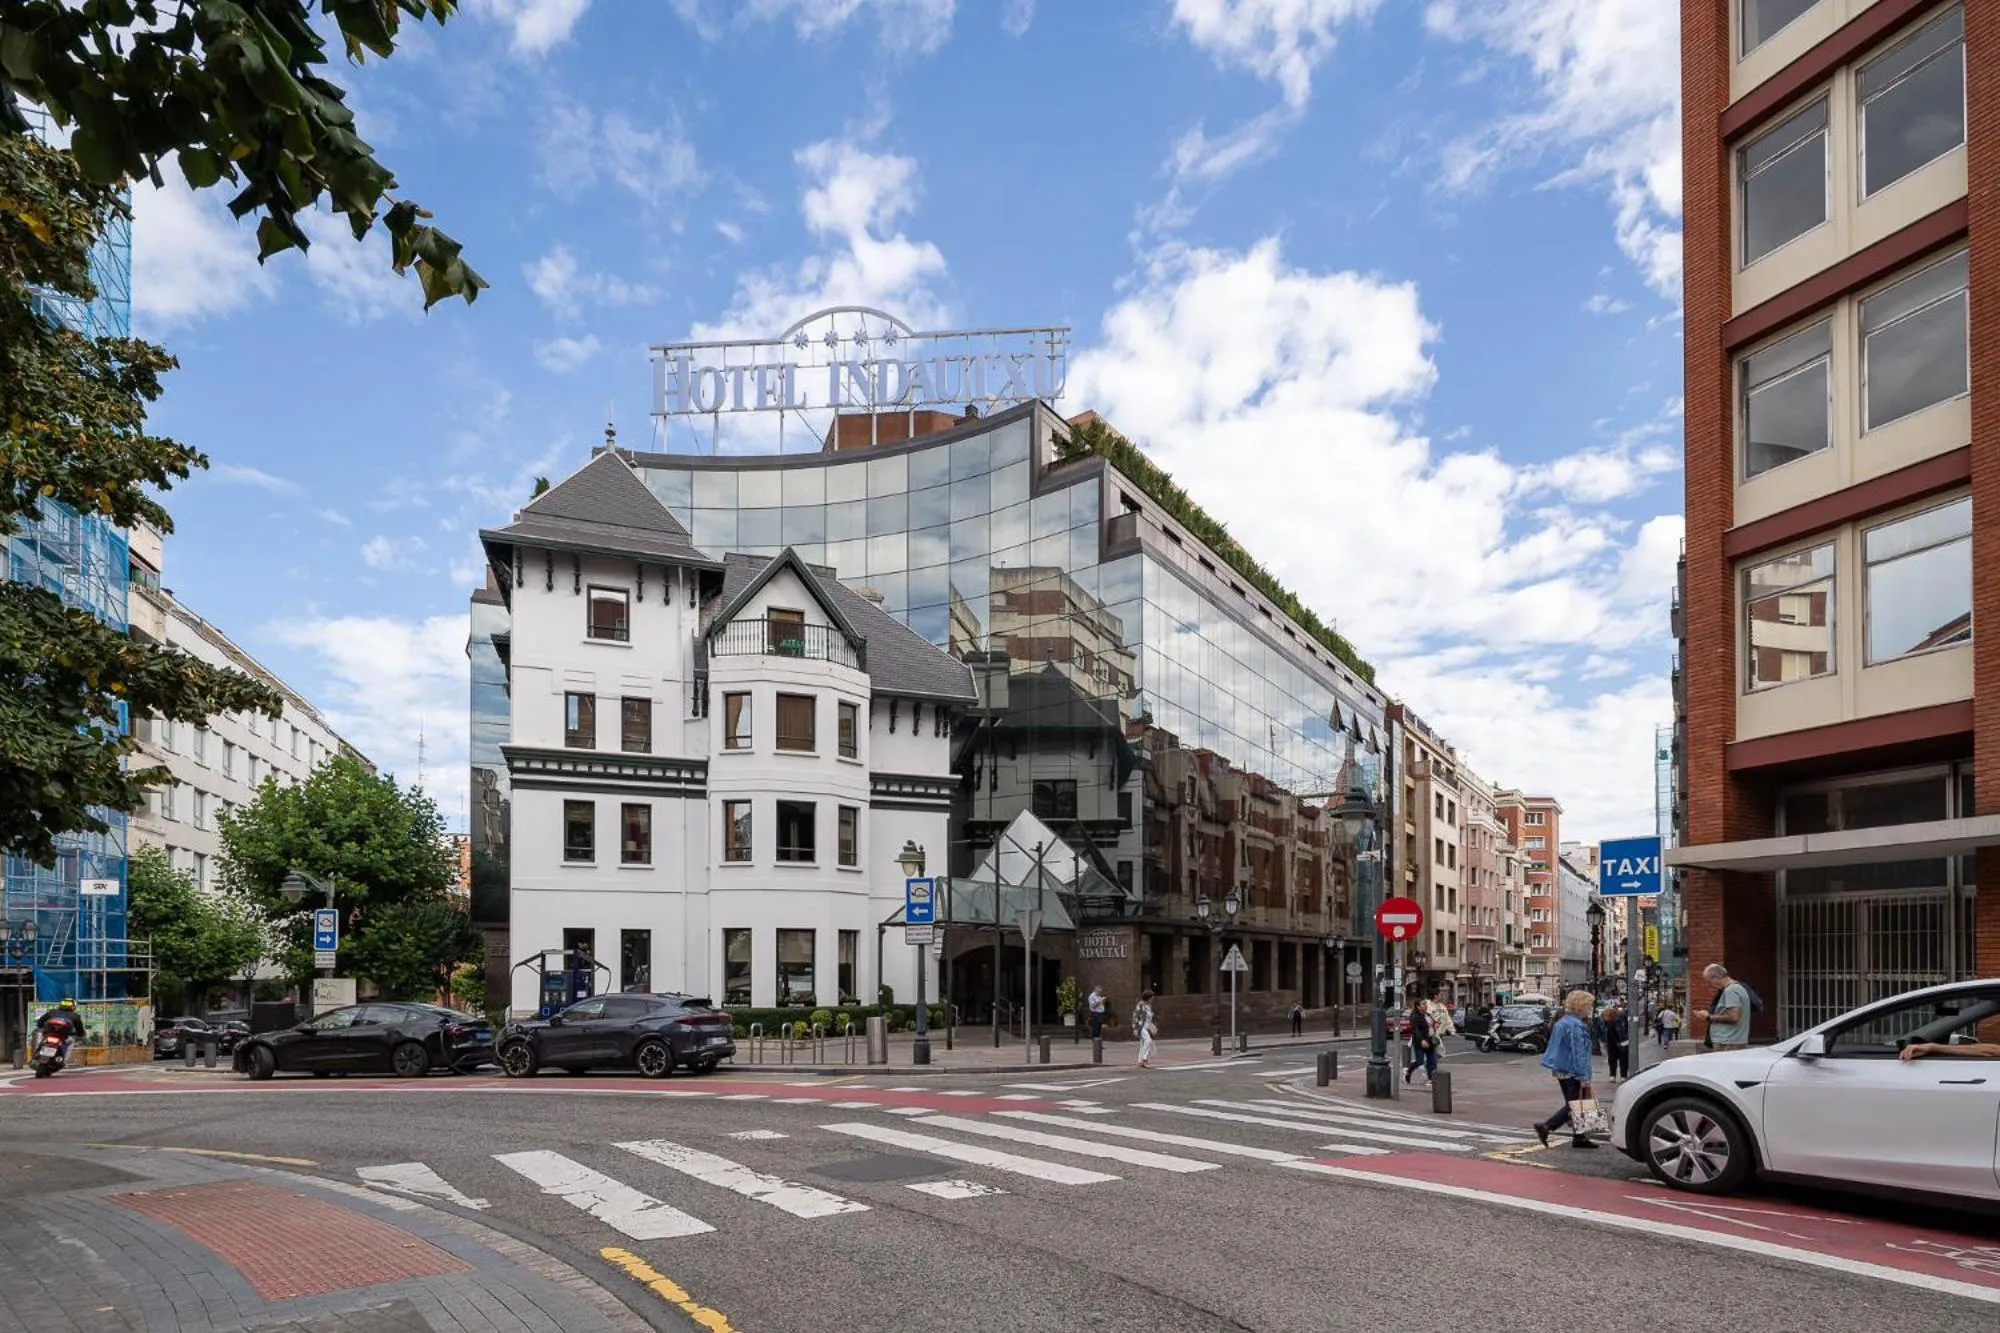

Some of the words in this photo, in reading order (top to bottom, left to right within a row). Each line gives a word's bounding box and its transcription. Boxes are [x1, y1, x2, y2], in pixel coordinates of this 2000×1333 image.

[650, 355, 806, 416] HOTEL
[826, 339, 1070, 408] INDAUTXU
[1602, 856, 1659, 877] TAXI
[1084, 935, 1118, 947] HOTEL
